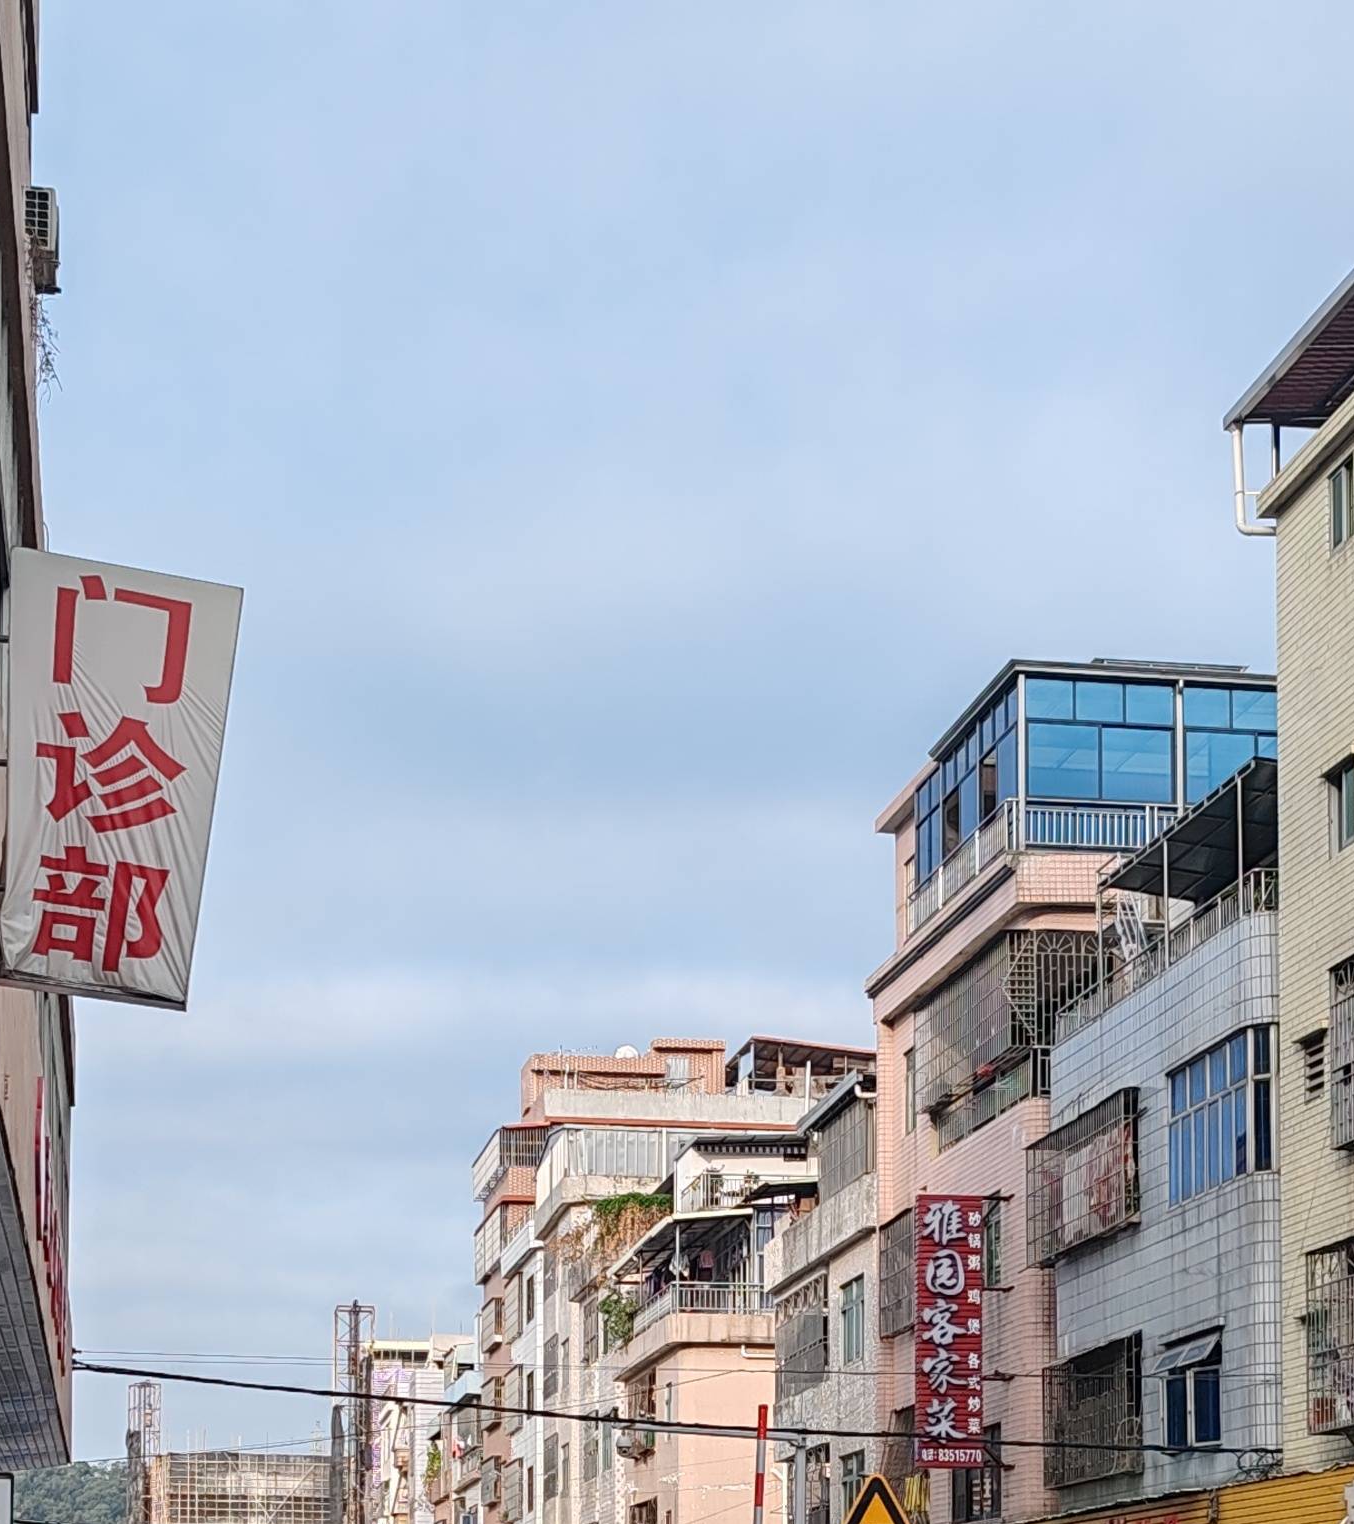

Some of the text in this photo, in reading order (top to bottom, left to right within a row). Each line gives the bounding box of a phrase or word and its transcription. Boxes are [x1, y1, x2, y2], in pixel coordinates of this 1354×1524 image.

[34, 575, 193, 974] 门诊部
[922, 1199, 968, 1445] 雅园客家菜
[967, 1351, 981, 1435] 各式炒菜
